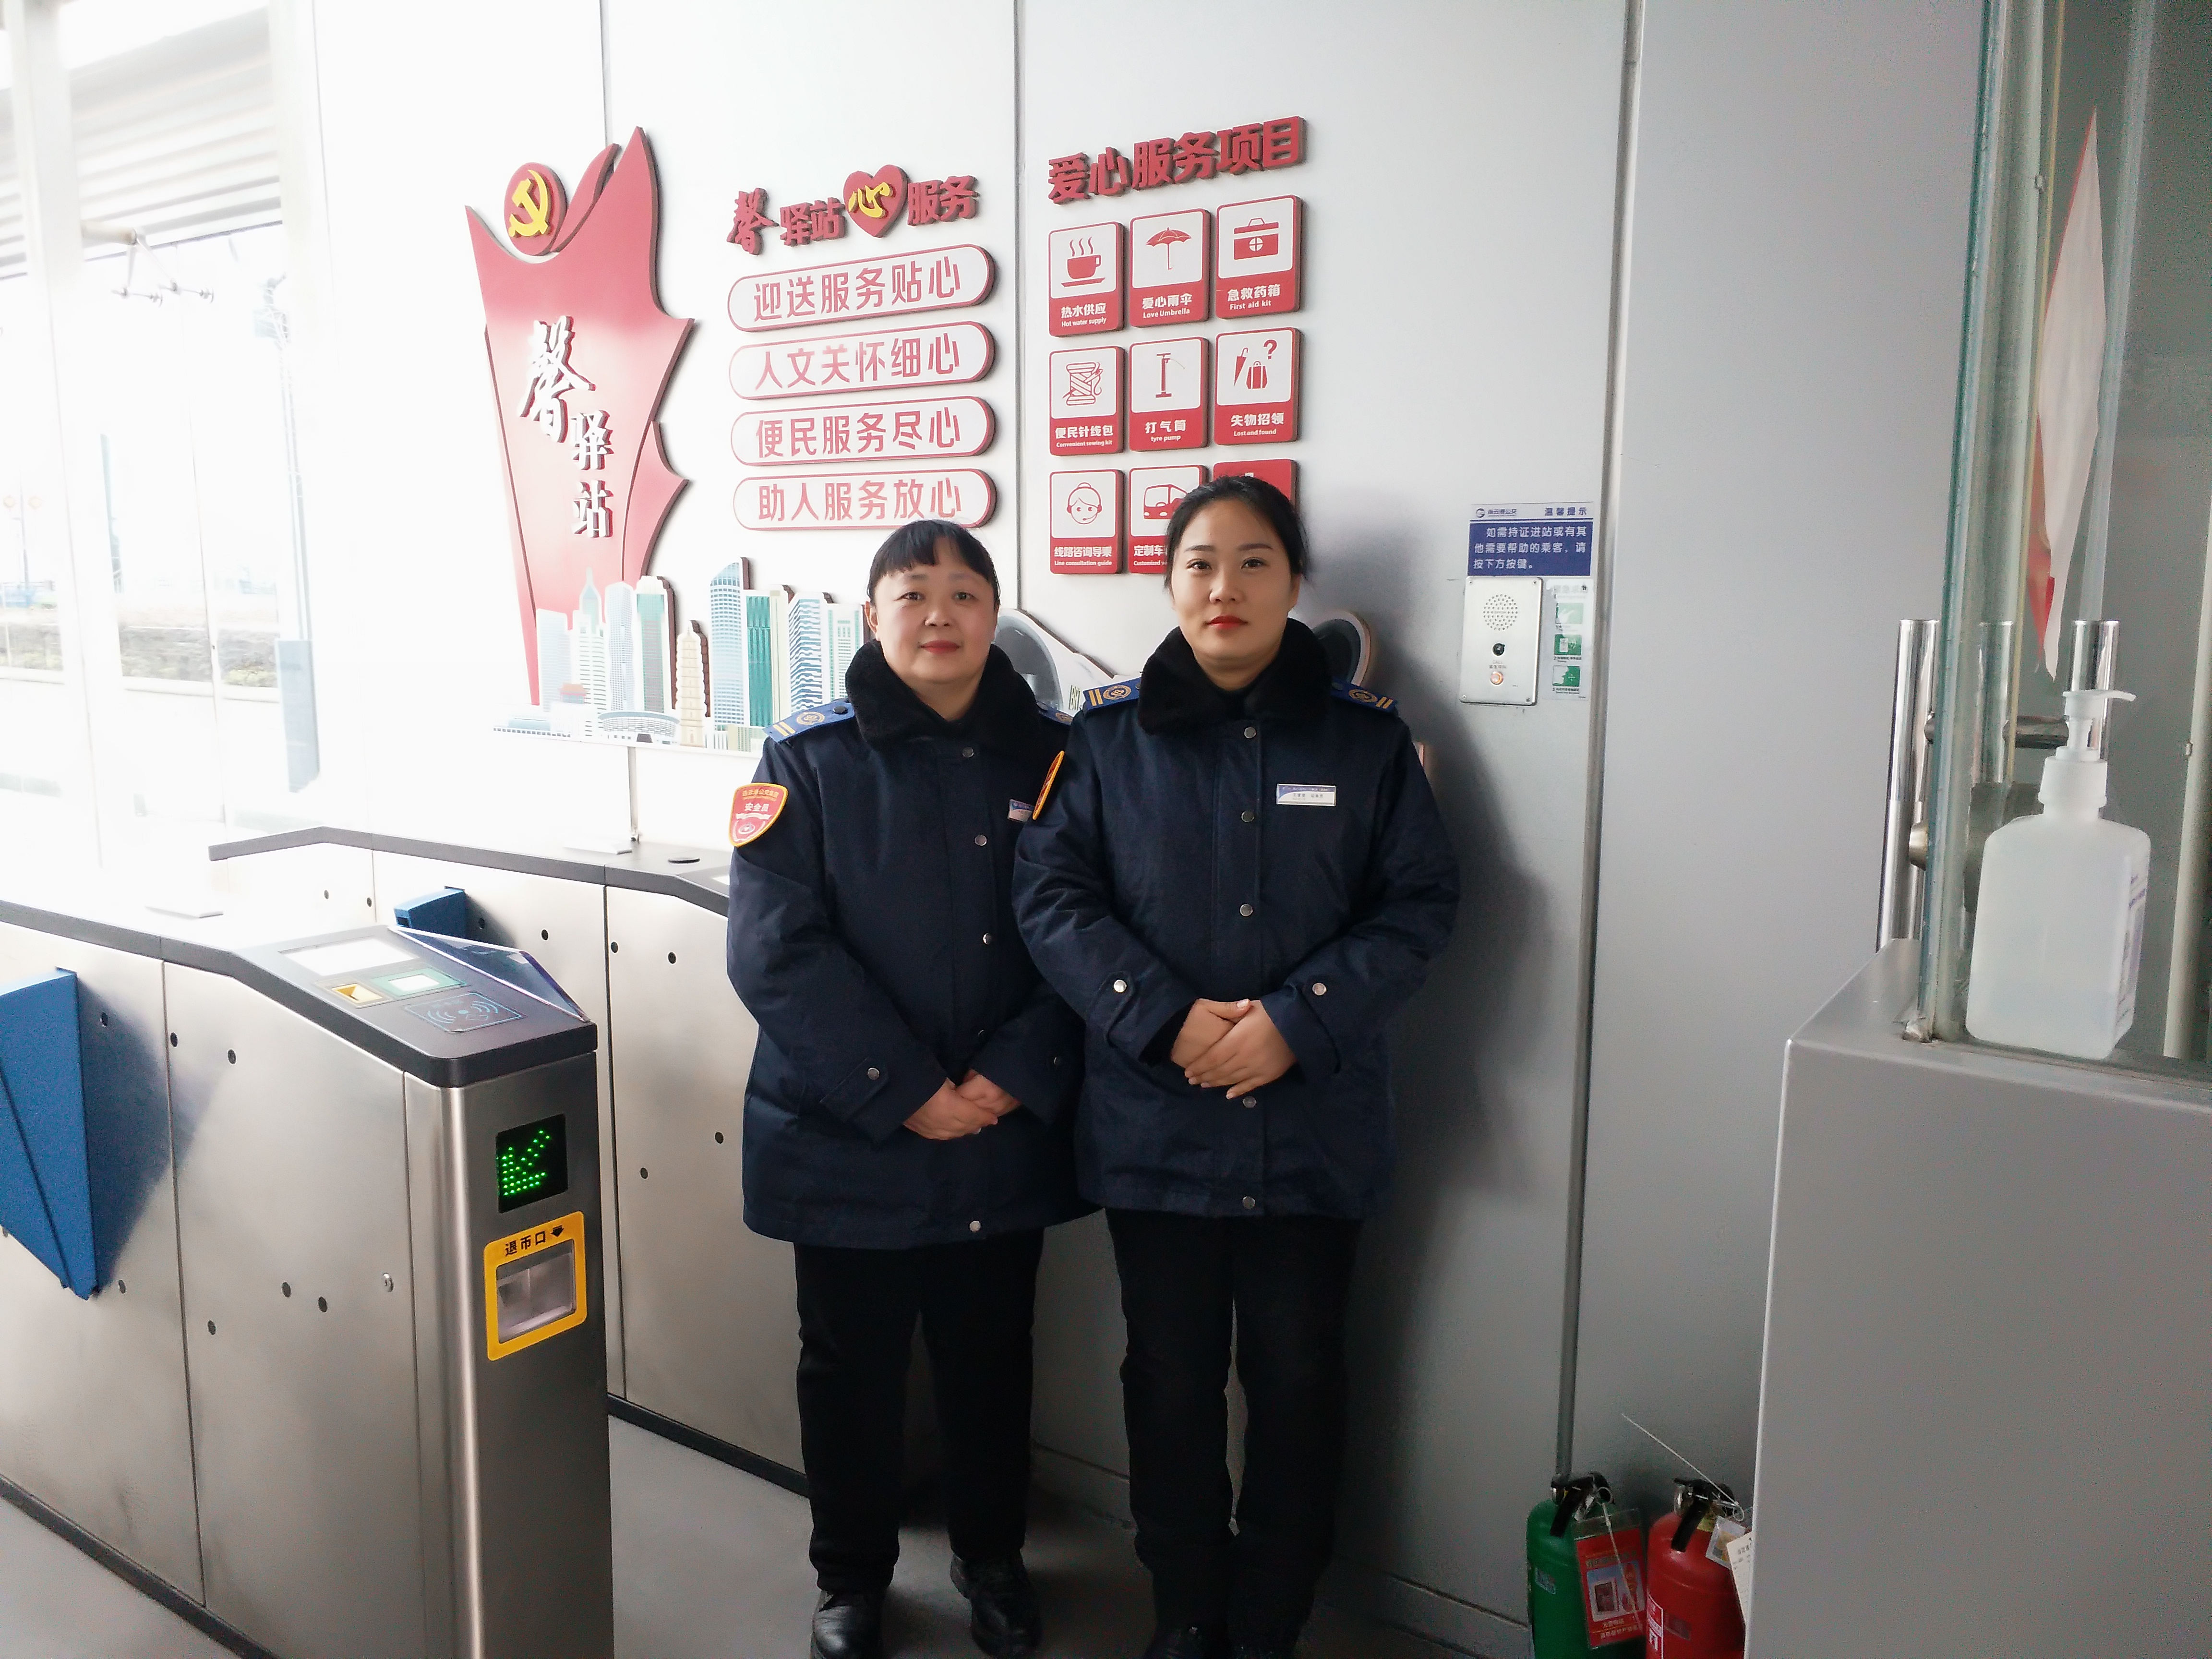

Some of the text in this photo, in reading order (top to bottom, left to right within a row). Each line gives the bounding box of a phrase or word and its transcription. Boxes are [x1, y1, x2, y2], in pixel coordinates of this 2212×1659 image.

[1048, 116, 1306, 204] 爱心服务项目
[754, 256, 961, 322] 迎送服务贴心
[1227, 284, 1280, 301] 急救药箱
[1142, 293, 1192, 310] 爱心雨伞
[1061, 302, 1106, 318] 热水供应
[1159, 307, 1190, 316] Umbrella
[1088, 316, 1106, 325] supply
[755, 333, 960, 391] 人文关怀细心
[517, 314, 613, 539] 馨驿站
[1145, 420, 1186, 434] 打气筒
[1230, 412, 1284, 427] 失物招领
[756, 407, 961, 458] 便民服务尽心
[1055, 425, 1113, 439] 便民针线包
[758, 477, 962, 522] 助人服务放心
[1545, 507, 1587, 516] 温馨提示
[1486, 526, 1587, 537] 如需持证进站或有其
[1054, 546, 1112, 557] 线路咨询导乘
[1133, 544, 1168, 556] 定制车
[1473, 559, 1533, 569] 按下方按键。
[745, 803, 769, 812] 安全员
[505, 1230, 546, 1257] 退币口
